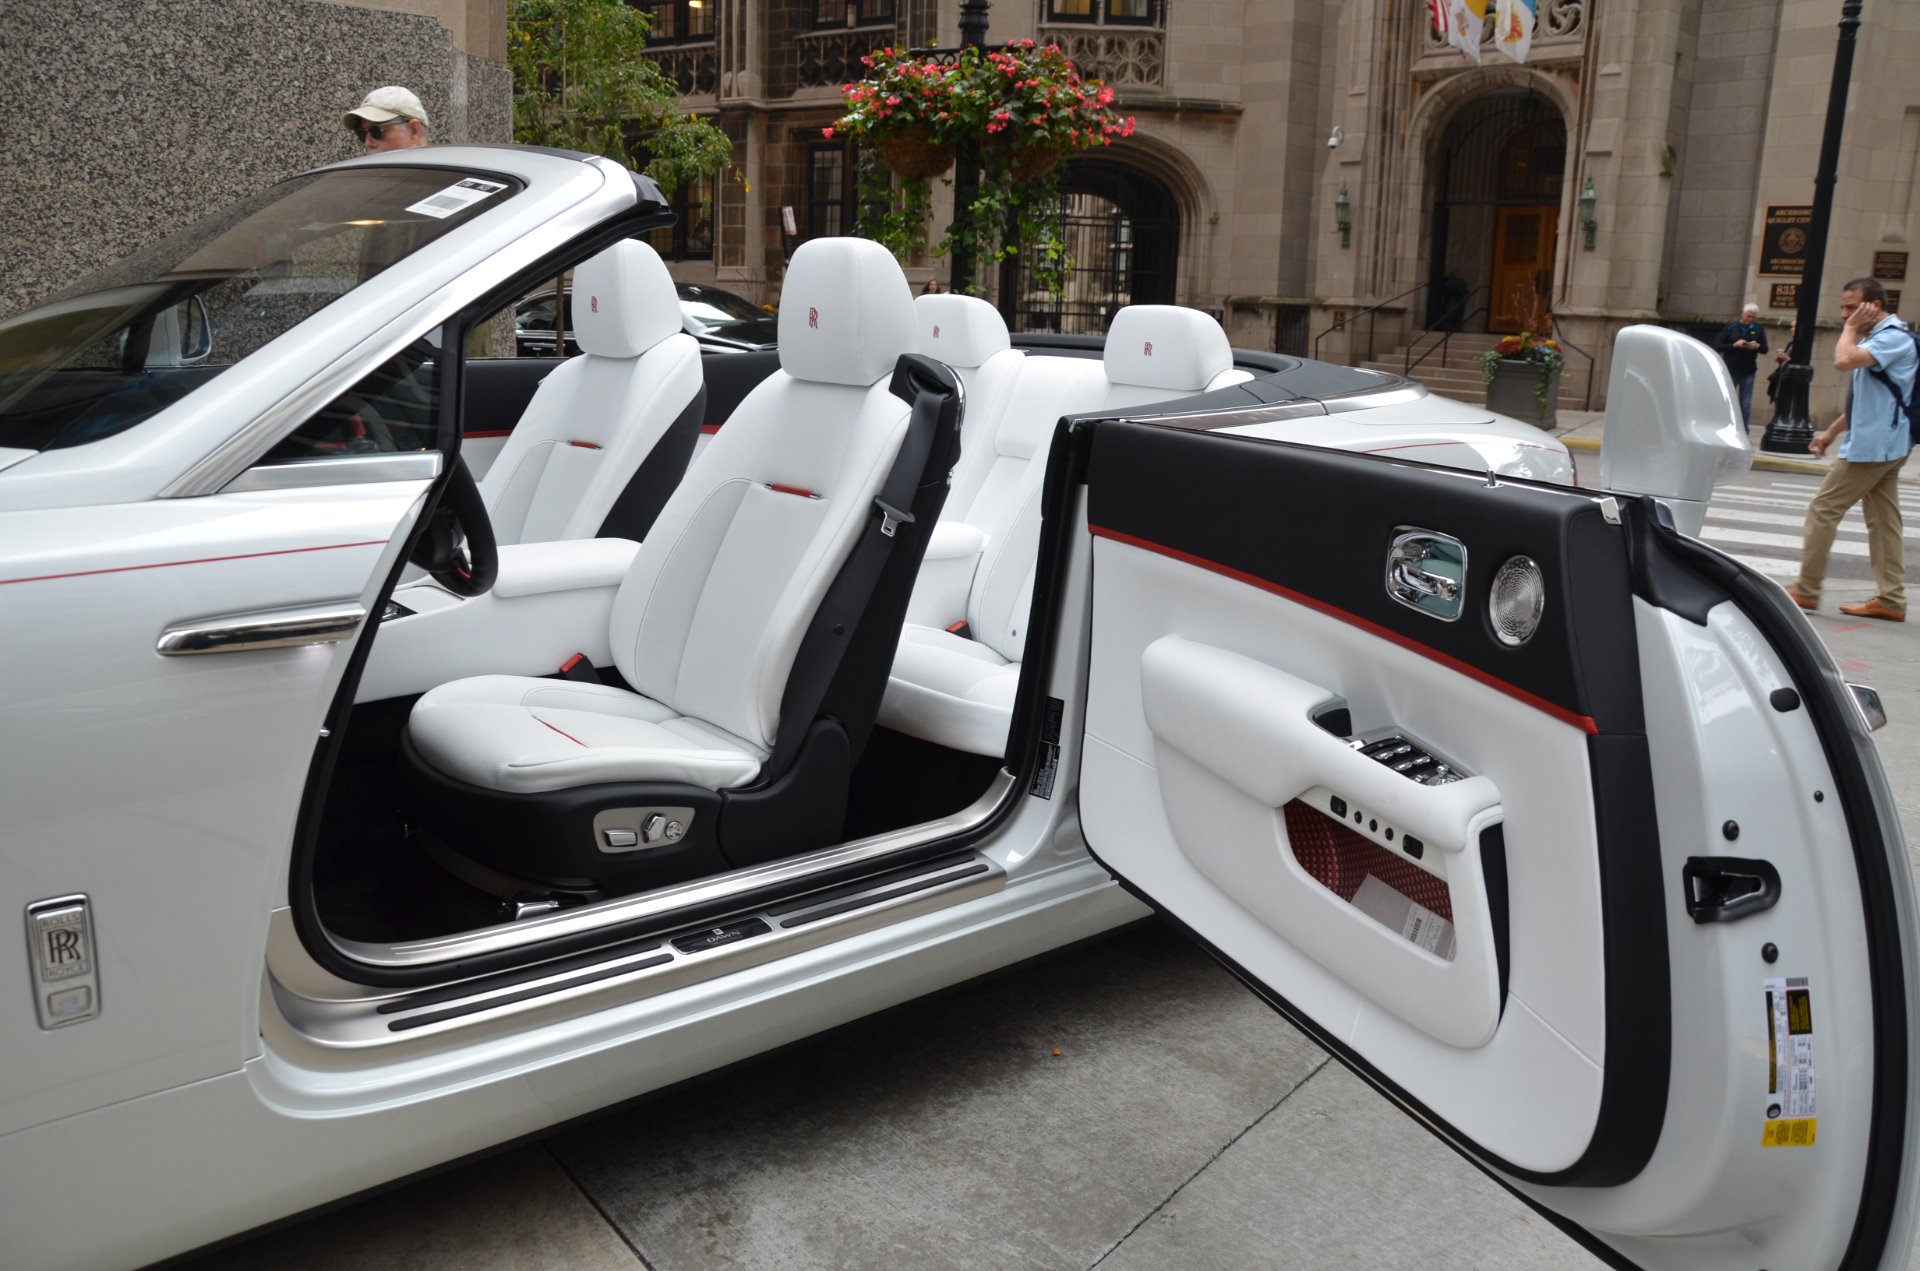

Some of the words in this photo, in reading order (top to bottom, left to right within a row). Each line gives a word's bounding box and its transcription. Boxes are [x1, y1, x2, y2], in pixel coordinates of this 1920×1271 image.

[1776, 285, 1796, 296] 835
[706, 931, 740, 942] DAWN
[48, 929, 81, 964] RR
